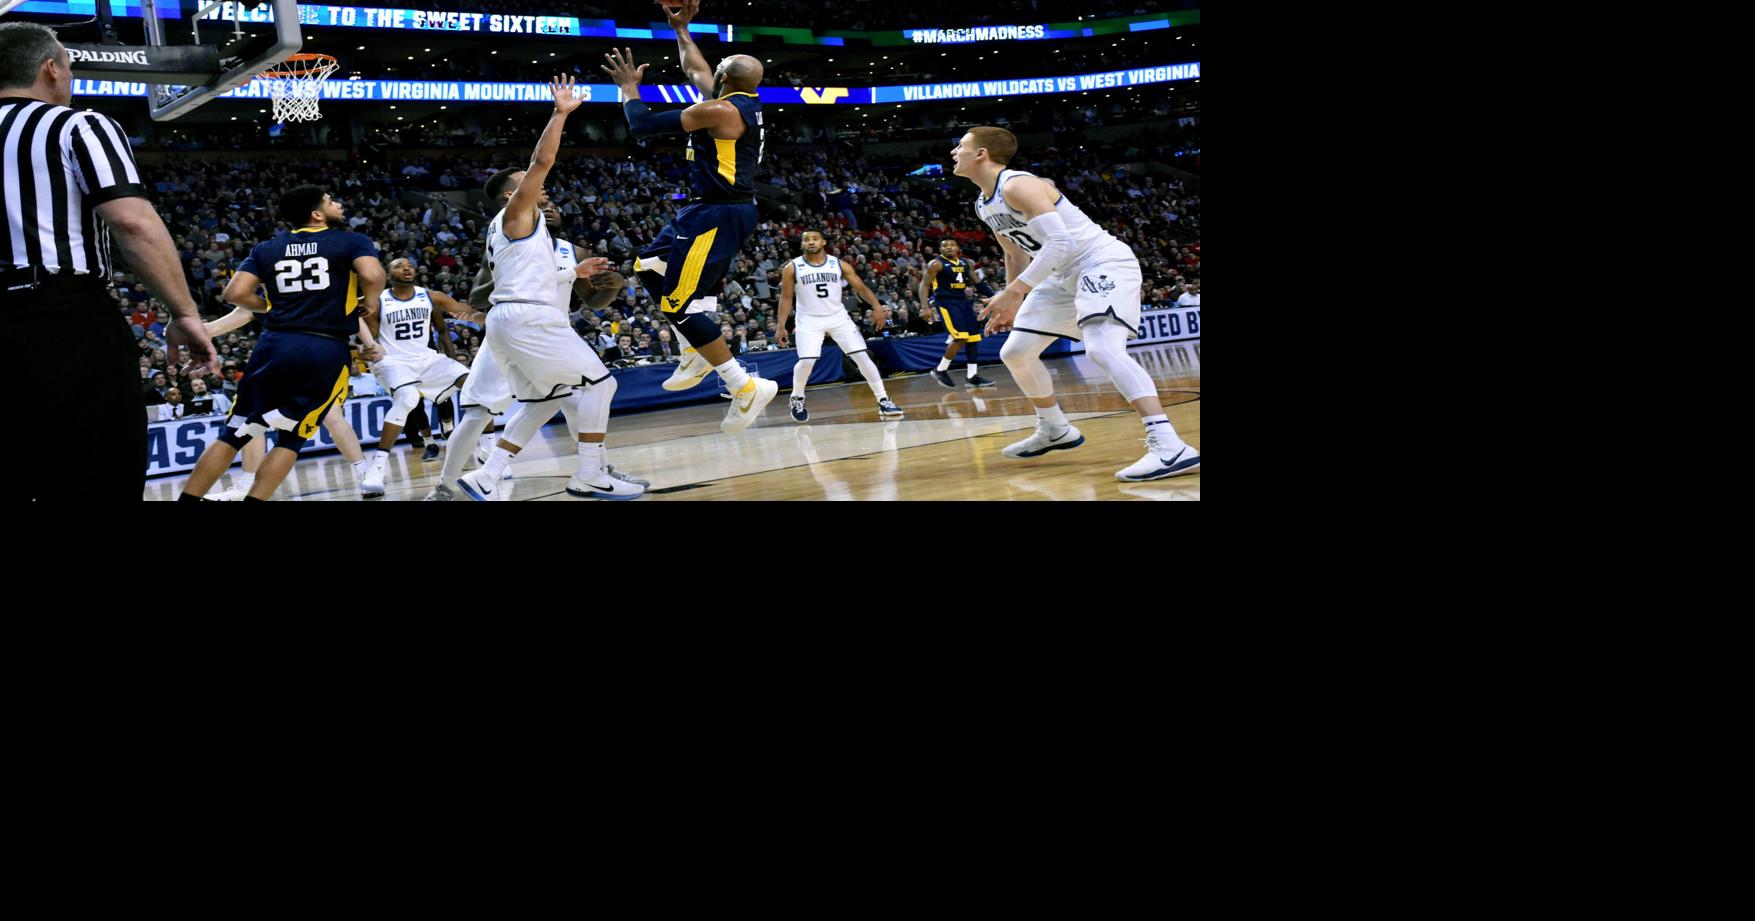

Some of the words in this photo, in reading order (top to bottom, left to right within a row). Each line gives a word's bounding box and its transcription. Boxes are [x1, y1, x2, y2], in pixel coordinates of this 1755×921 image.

[198, 0, 320, 24] WELCE
[328, 7, 356, 25] TO
[365, 9, 404, 28] THE
[412, 11, 483, 31] SWEET
[912, 25, 1044, 43] #MARCHMADNESS
[65, 48, 150, 65] PALDING
[903, 82, 981, 101] VILLANOVA
[983, 78, 1054, 99] WILDCATS
[1057, 77, 1076, 92] VS
[1079, 72, 1125, 90] WEST
[1127, 63, 1200, 85] VIRGINIA
[321, 82, 377, 99] WEST
[380, 82, 460, 100] VIRGINIA
[463, 84, 592, 102] MOUNTAINRS
[285, 242, 317, 257] AHMAD
[274, 256, 330, 294] 23
[800, 272, 838, 286] VILLANOVA
[955, 272, 964, 283] 4
[816, 283, 829, 299] 5
[386, 307, 429, 325] VILLANOVA
[1137, 310, 1181, 340] STED
[395, 320, 425, 341] 25
